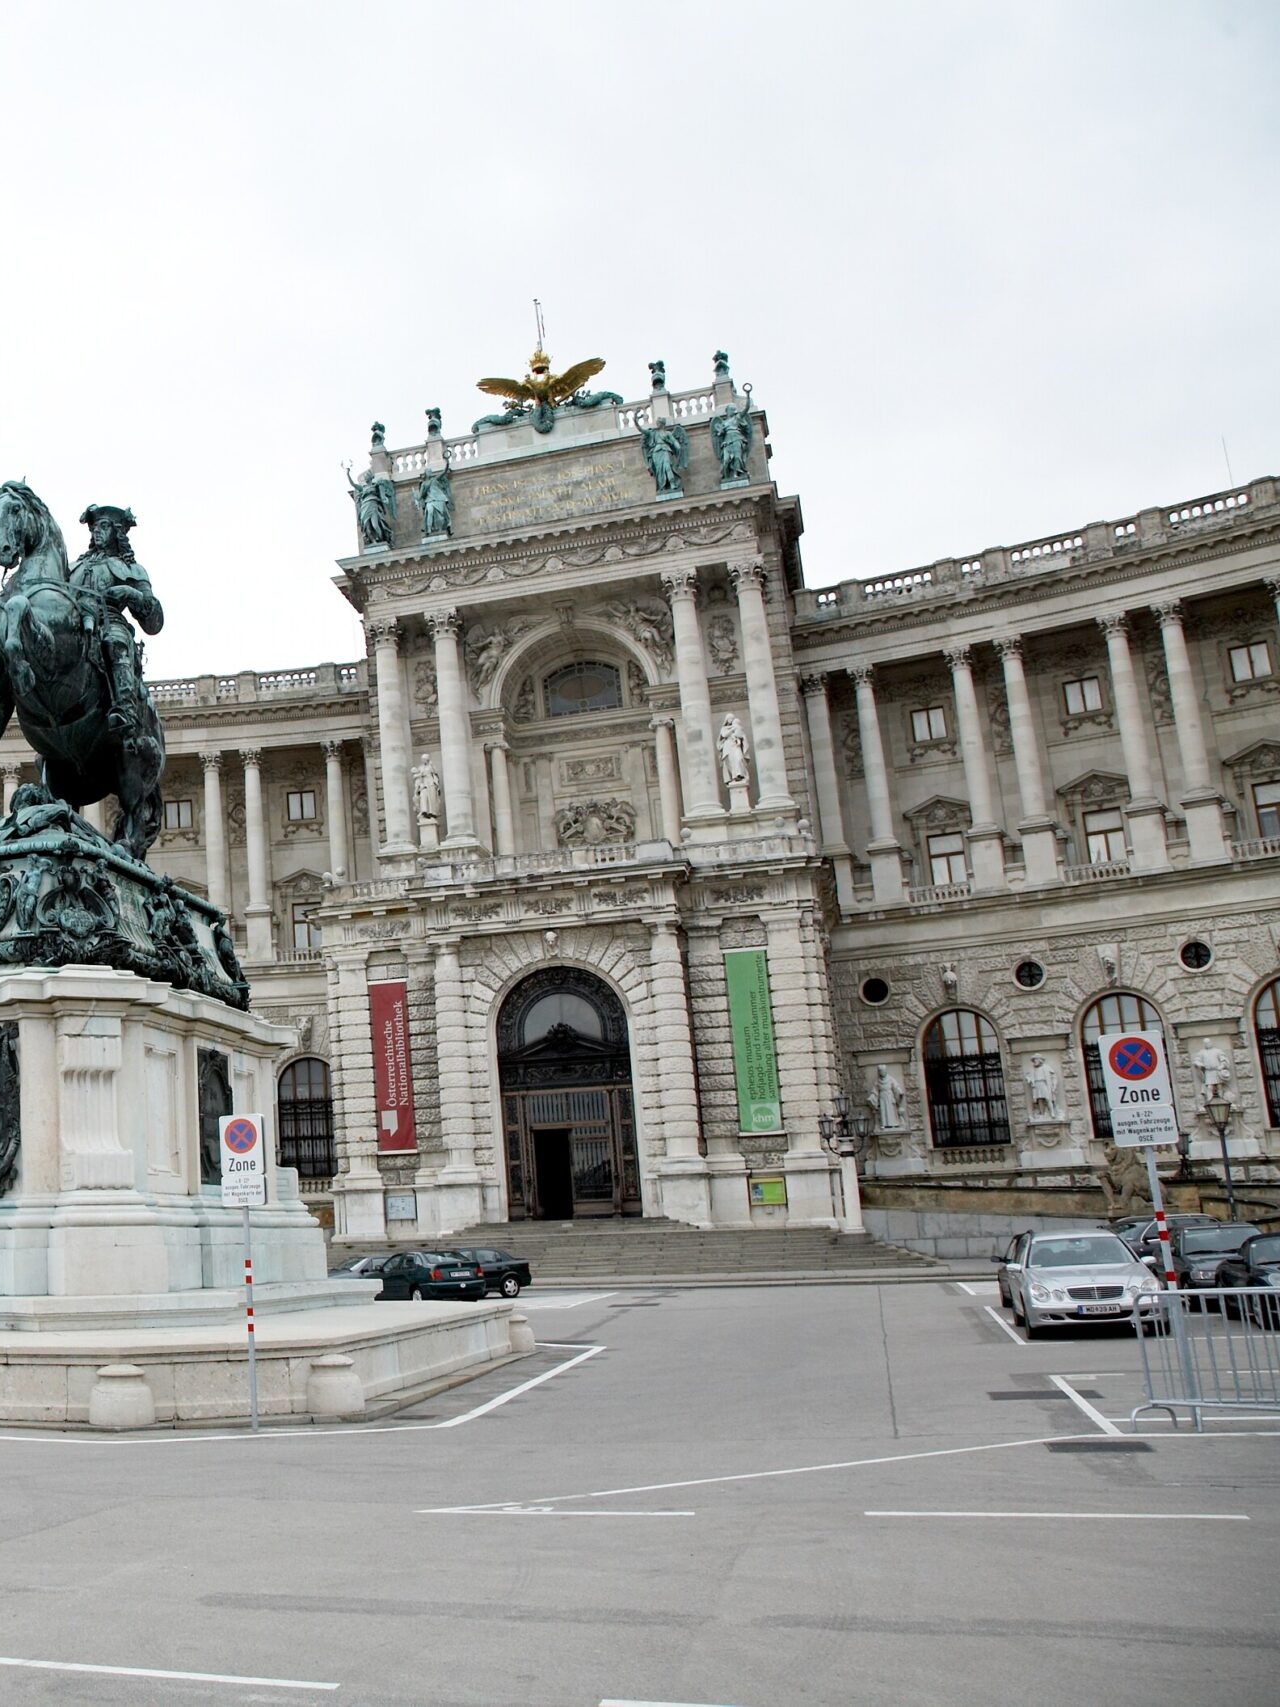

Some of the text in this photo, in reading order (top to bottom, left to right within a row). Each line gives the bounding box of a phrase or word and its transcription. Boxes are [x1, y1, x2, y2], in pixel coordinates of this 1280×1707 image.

[764, 1030, 773, 1051] alter
[393, 1000, 409, 1106] Nationalbibliothek
[752, 1044, 763, 1060] und
[384, 1020, 397, 1107] Österreichische
[743, 1026, 756, 1101] ephesos museum
[1118, 1086, 1161, 1104] Zone
[752, 1112, 774, 1124] khm
[1127, 1126, 1163, 1136] Wagenkarte
[1164, 1125, 1174, 1133] der
[228, 1157, 256, 1172] Zone
